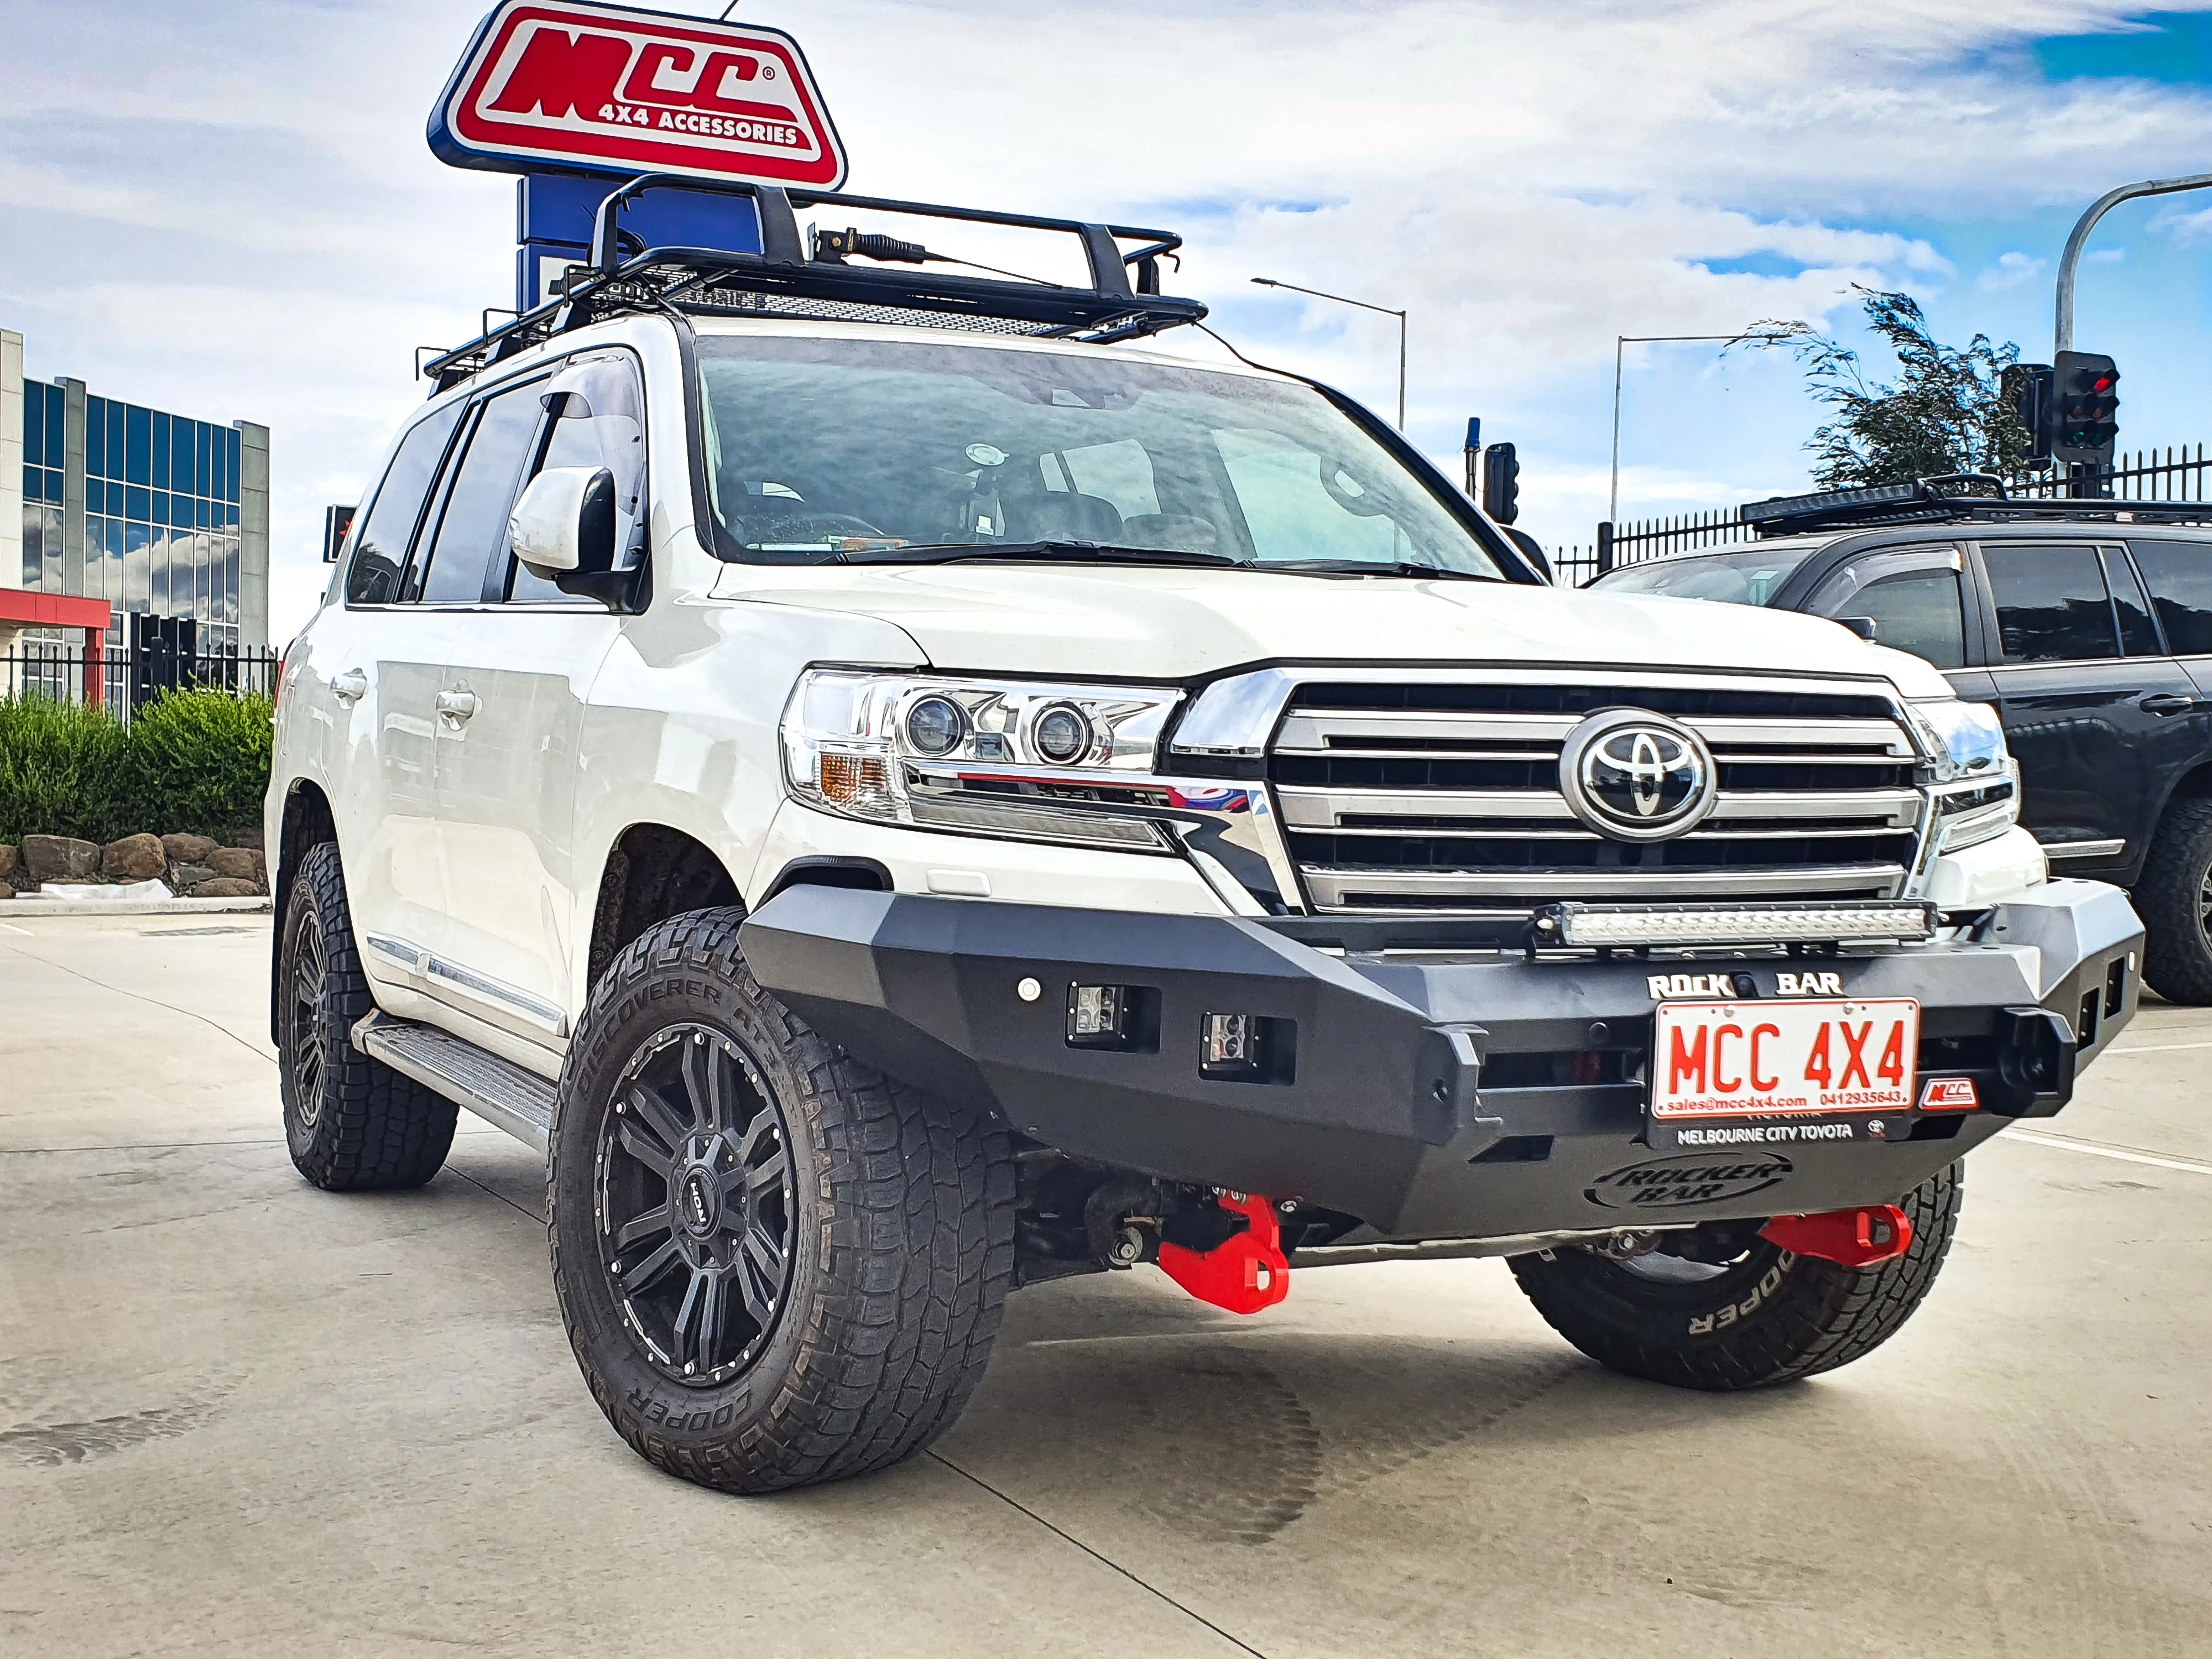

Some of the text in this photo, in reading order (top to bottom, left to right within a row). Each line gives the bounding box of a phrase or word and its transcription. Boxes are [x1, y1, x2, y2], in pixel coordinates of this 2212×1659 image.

[485, 27, 799, 118] MCC
[598, 103, 797, 145] 4X4 ACCESSORIES
[1776, 972, 1844, 995] BAR
[1668, 1019, 1904, 1094] MCC 4X4
[1667, 1094, 1808, 1111] sales@mcc4x4.com
[1678, 1124, 1853, 1146] MELBOURNE CITY TOYOTA
[1614, 1162, 1793, 1187] ROCKER
[1627, 1182, 1726, 1204] BAR
[1688, 1248, 1799, 1335] OOPER
[627, 1386, 751, 1431] COOPER
